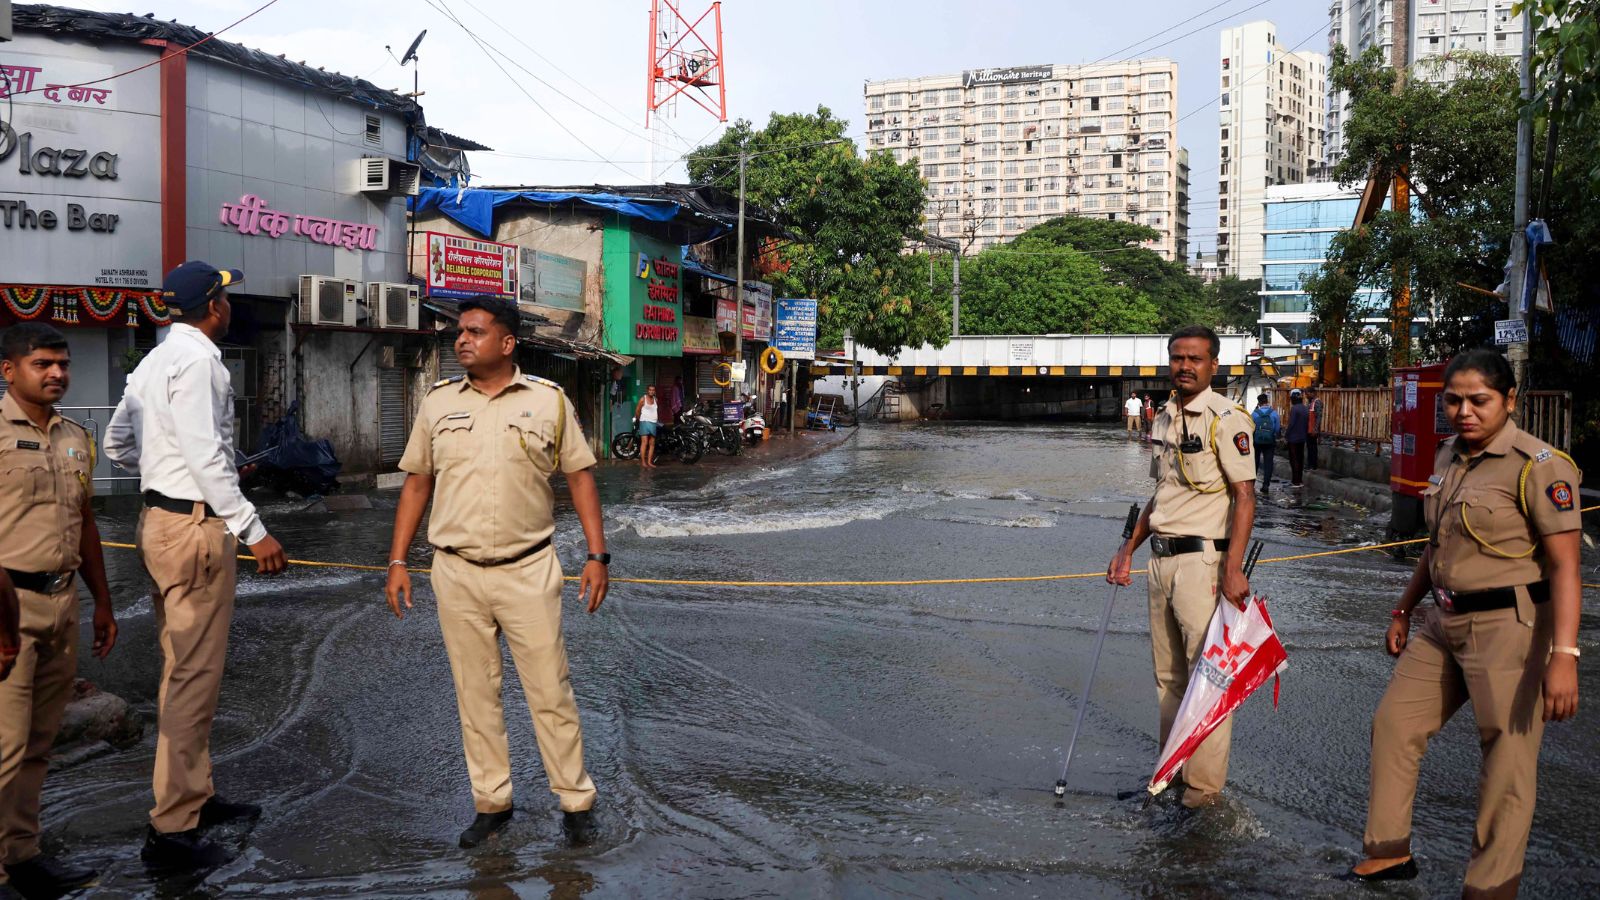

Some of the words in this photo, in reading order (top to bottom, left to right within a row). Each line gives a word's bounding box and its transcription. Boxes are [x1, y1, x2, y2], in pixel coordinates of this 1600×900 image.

[965, 70, 1020, 88] Millionaire
[44, 84, 61, 102] द
[68, 86, 112, 104] बार
[0, 200, 58, 229] The
[67, 203, 120, 233] Bar
[446, 264, 470, 276] RELIABLE
[470, 267, 502, 279] CORPORATION
[636, 323, 679, 342] DORMITORY
